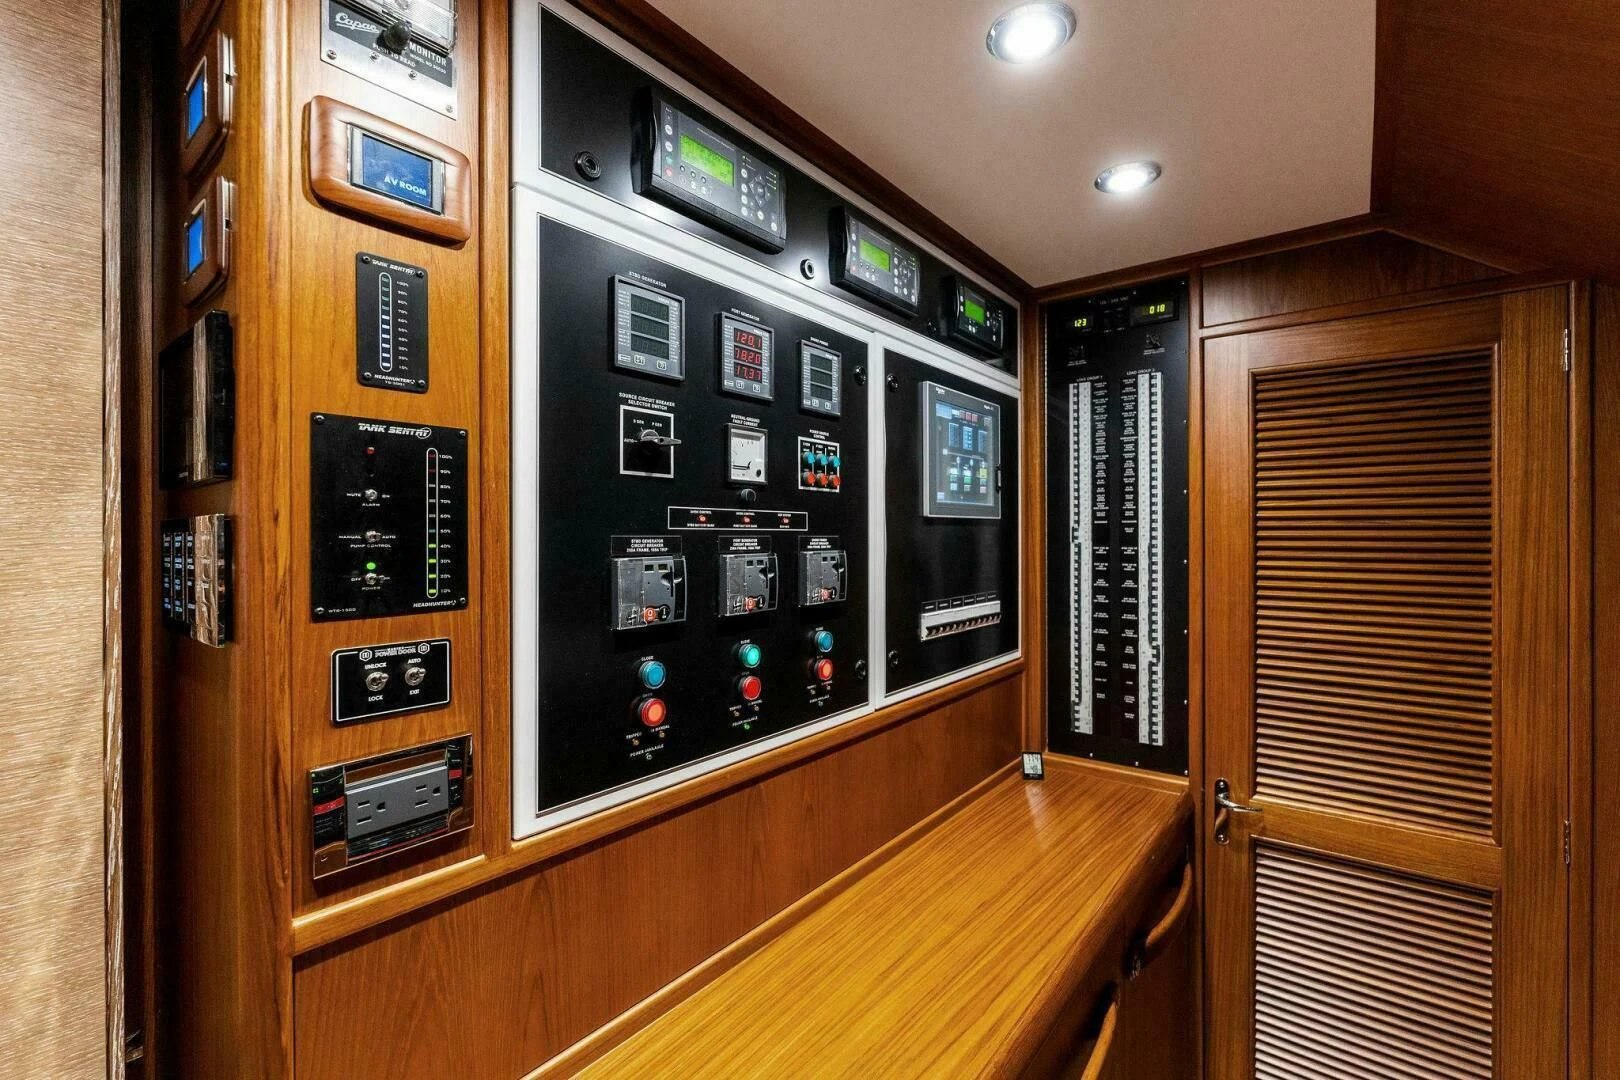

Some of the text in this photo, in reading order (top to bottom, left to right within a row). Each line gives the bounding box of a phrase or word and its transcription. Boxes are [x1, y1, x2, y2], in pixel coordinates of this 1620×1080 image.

[409, 40, 447, 67] MONITOR
[384, 176, 426, 196] AV ROOM
[372, 259, 388, 268] TANK
[641, 276, 667, 288] GENERATOR
[628, 399, 650, 408] SELECTOR
[656, 399, 675, 407] BREAKER
[358, 422, 431, 438] TANK SENTRY
[630, 744, 664, 758] POWER AVAILABLE
